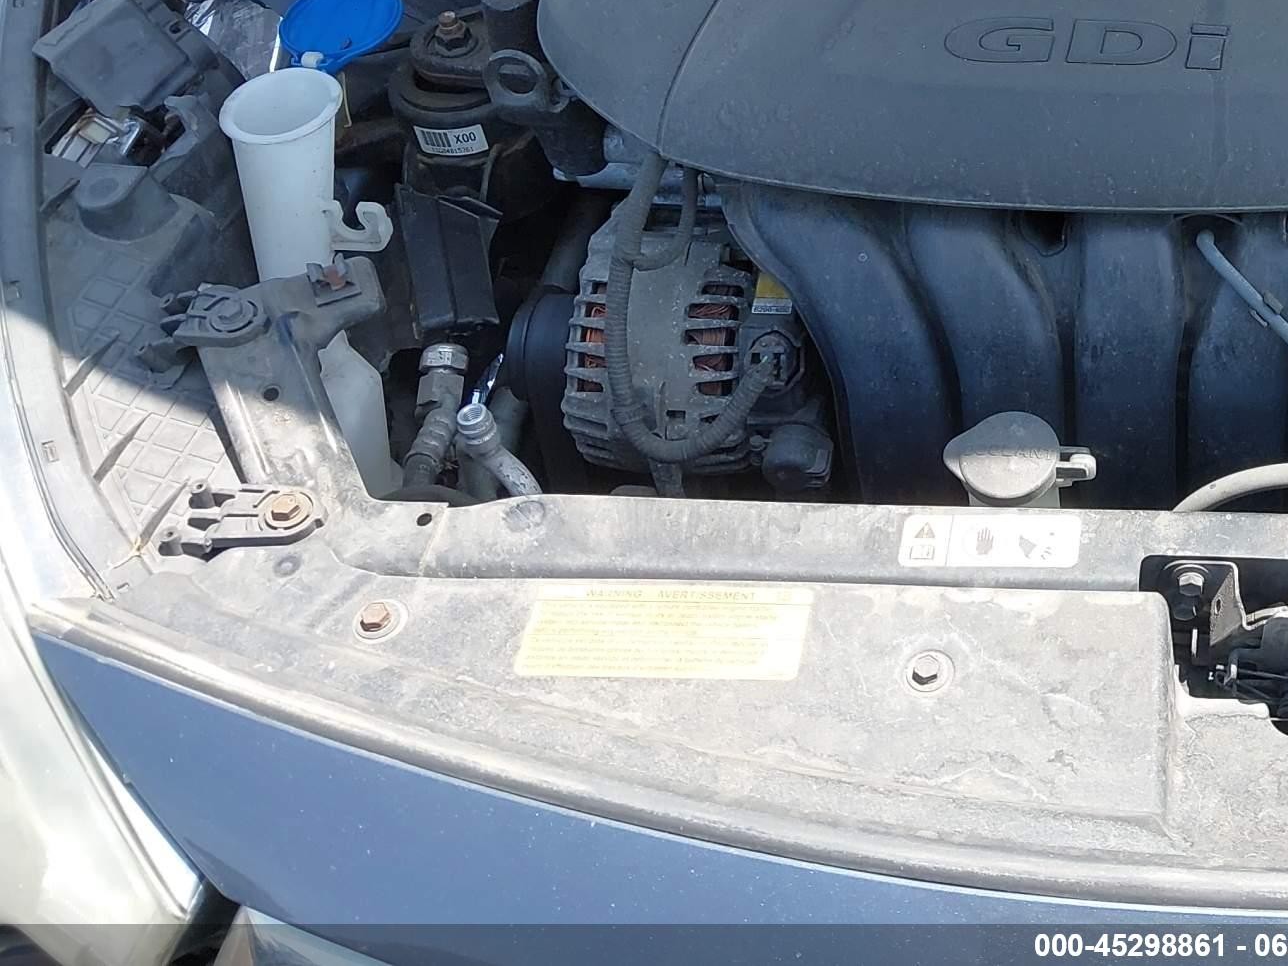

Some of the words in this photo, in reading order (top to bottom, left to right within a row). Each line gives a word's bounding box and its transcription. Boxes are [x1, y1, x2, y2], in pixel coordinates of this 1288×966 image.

[944, 16, 1229, 70] GDi
[453, 131, 477, 145] X00
[586, 589, 643, 599] WARNING
[657, 589, 757, 601] AVERTISSEMENT
